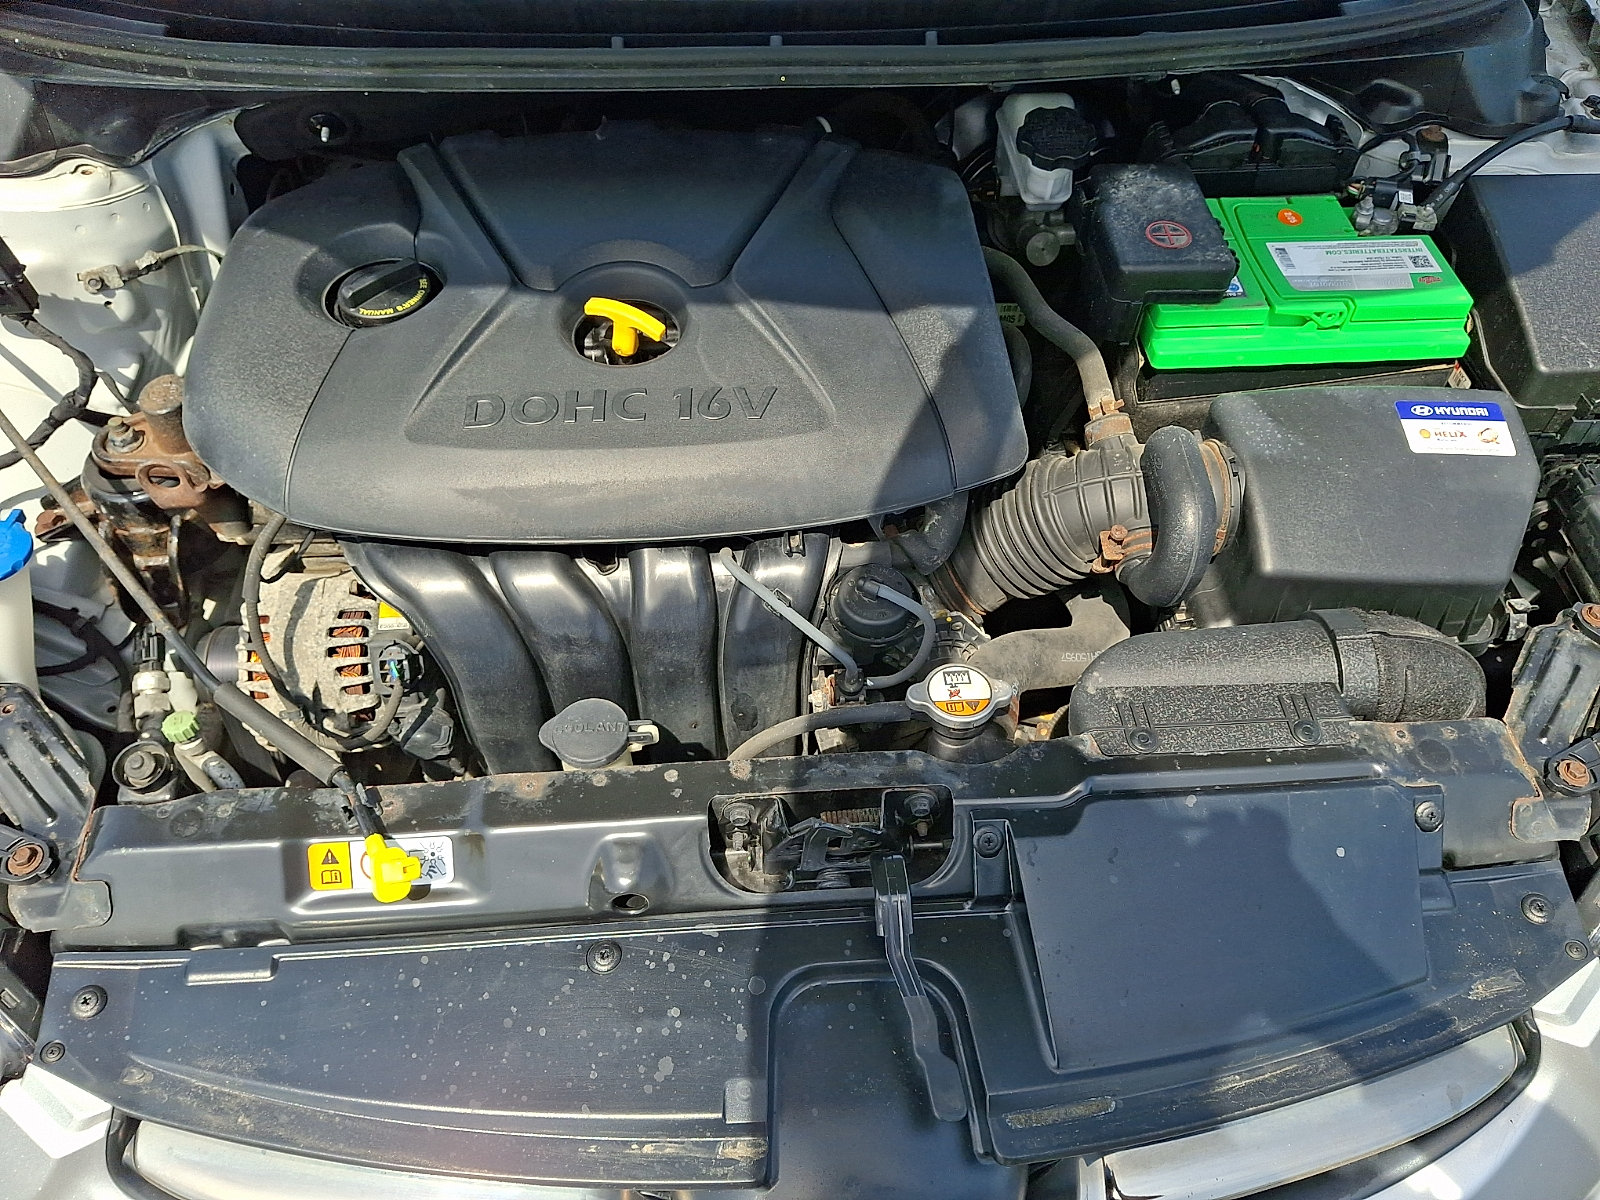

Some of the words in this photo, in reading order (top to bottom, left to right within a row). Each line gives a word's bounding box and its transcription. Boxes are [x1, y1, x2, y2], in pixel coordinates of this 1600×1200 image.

[1325, 248, 1423, 256] INTERSTATEBATTERIES.COM
[359, 307, 395, 316] MANUAL
[463, 387, 648, 429] DOHC
[673, 386, 778, 421] 16V
[1434, 406, 1489, 417] HYUNDAI
[554, 721, 627, 736] COOLANT
